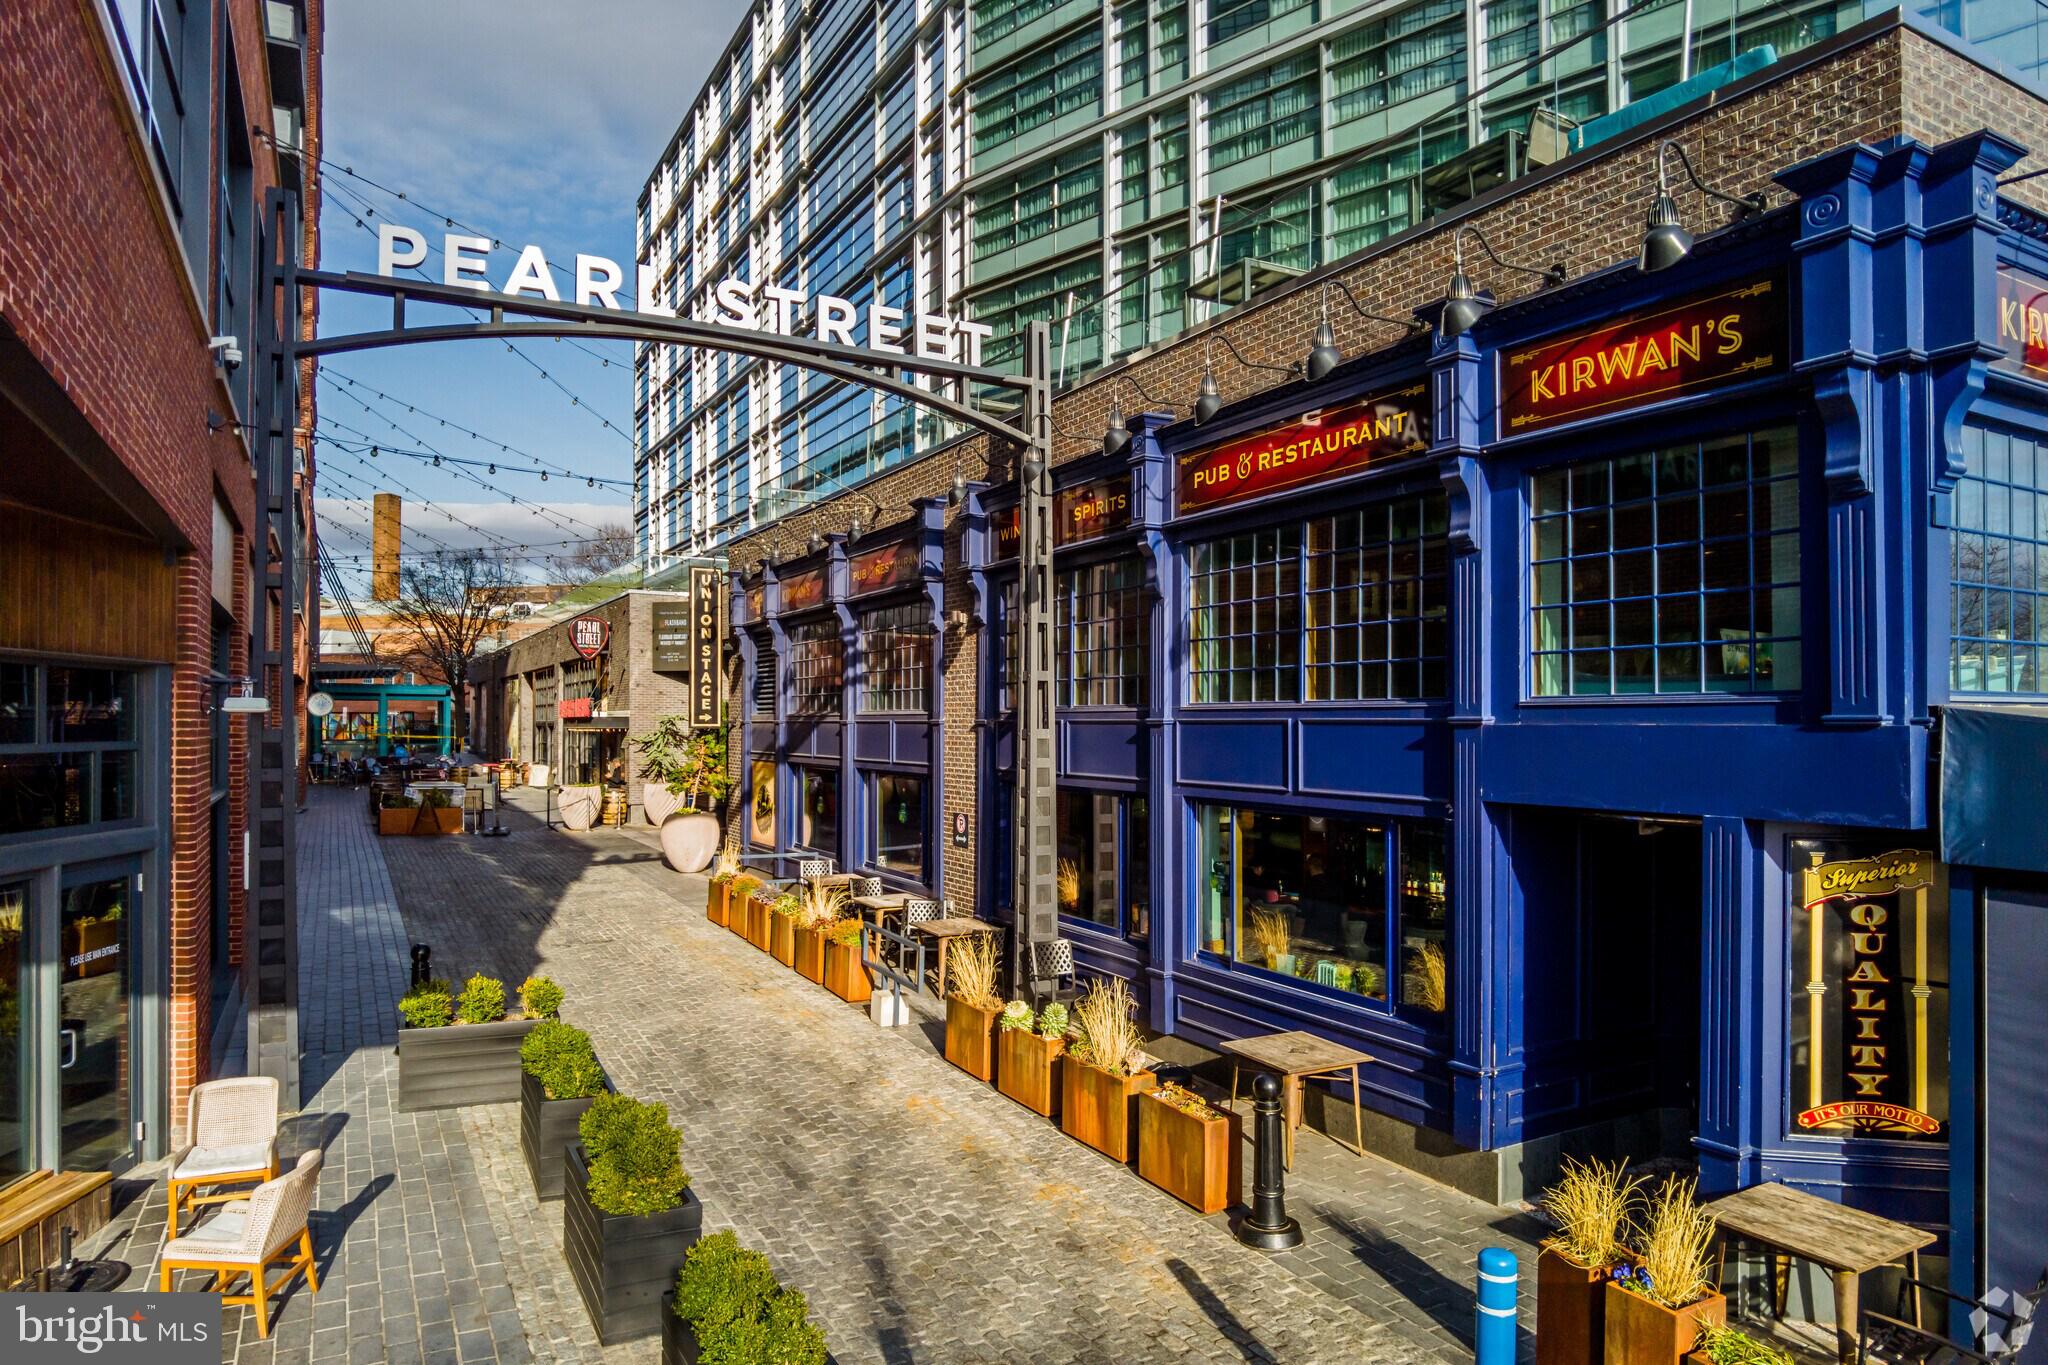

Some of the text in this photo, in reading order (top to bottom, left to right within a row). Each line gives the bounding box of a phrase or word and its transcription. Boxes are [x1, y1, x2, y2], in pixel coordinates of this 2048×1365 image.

[378, 223, 993, 368] PEARL STREET
[2001, 296, 2048, 350] KIR
[1531, 314, 1743, 403] KIRWAN'S
[1193, 463, 1230, 489] PUB
[1236, 451, 1254, 480] &
[1257, 411, 1409, 472] RESTAURANT
[1000, 494, 1126, 541] WIN SPIRITS
[852, 568, 868, 583] PUB
[875, 554, 919, 577] RESTAURAN
[576, 633, 601, 645] STREET
[577, 621, 601, 633] PEARL
[700, 574, 712, 711] UNION STAGE
[1822, 859, 1918, 891] Superior
[70, 943, 120, 966] PLEASE USE MAIN ENTRANCE
[1849, 904, 1888, 1095] QUALITY
[1814, 1104, 1923, 1125] IT'S OUR MOTTO
